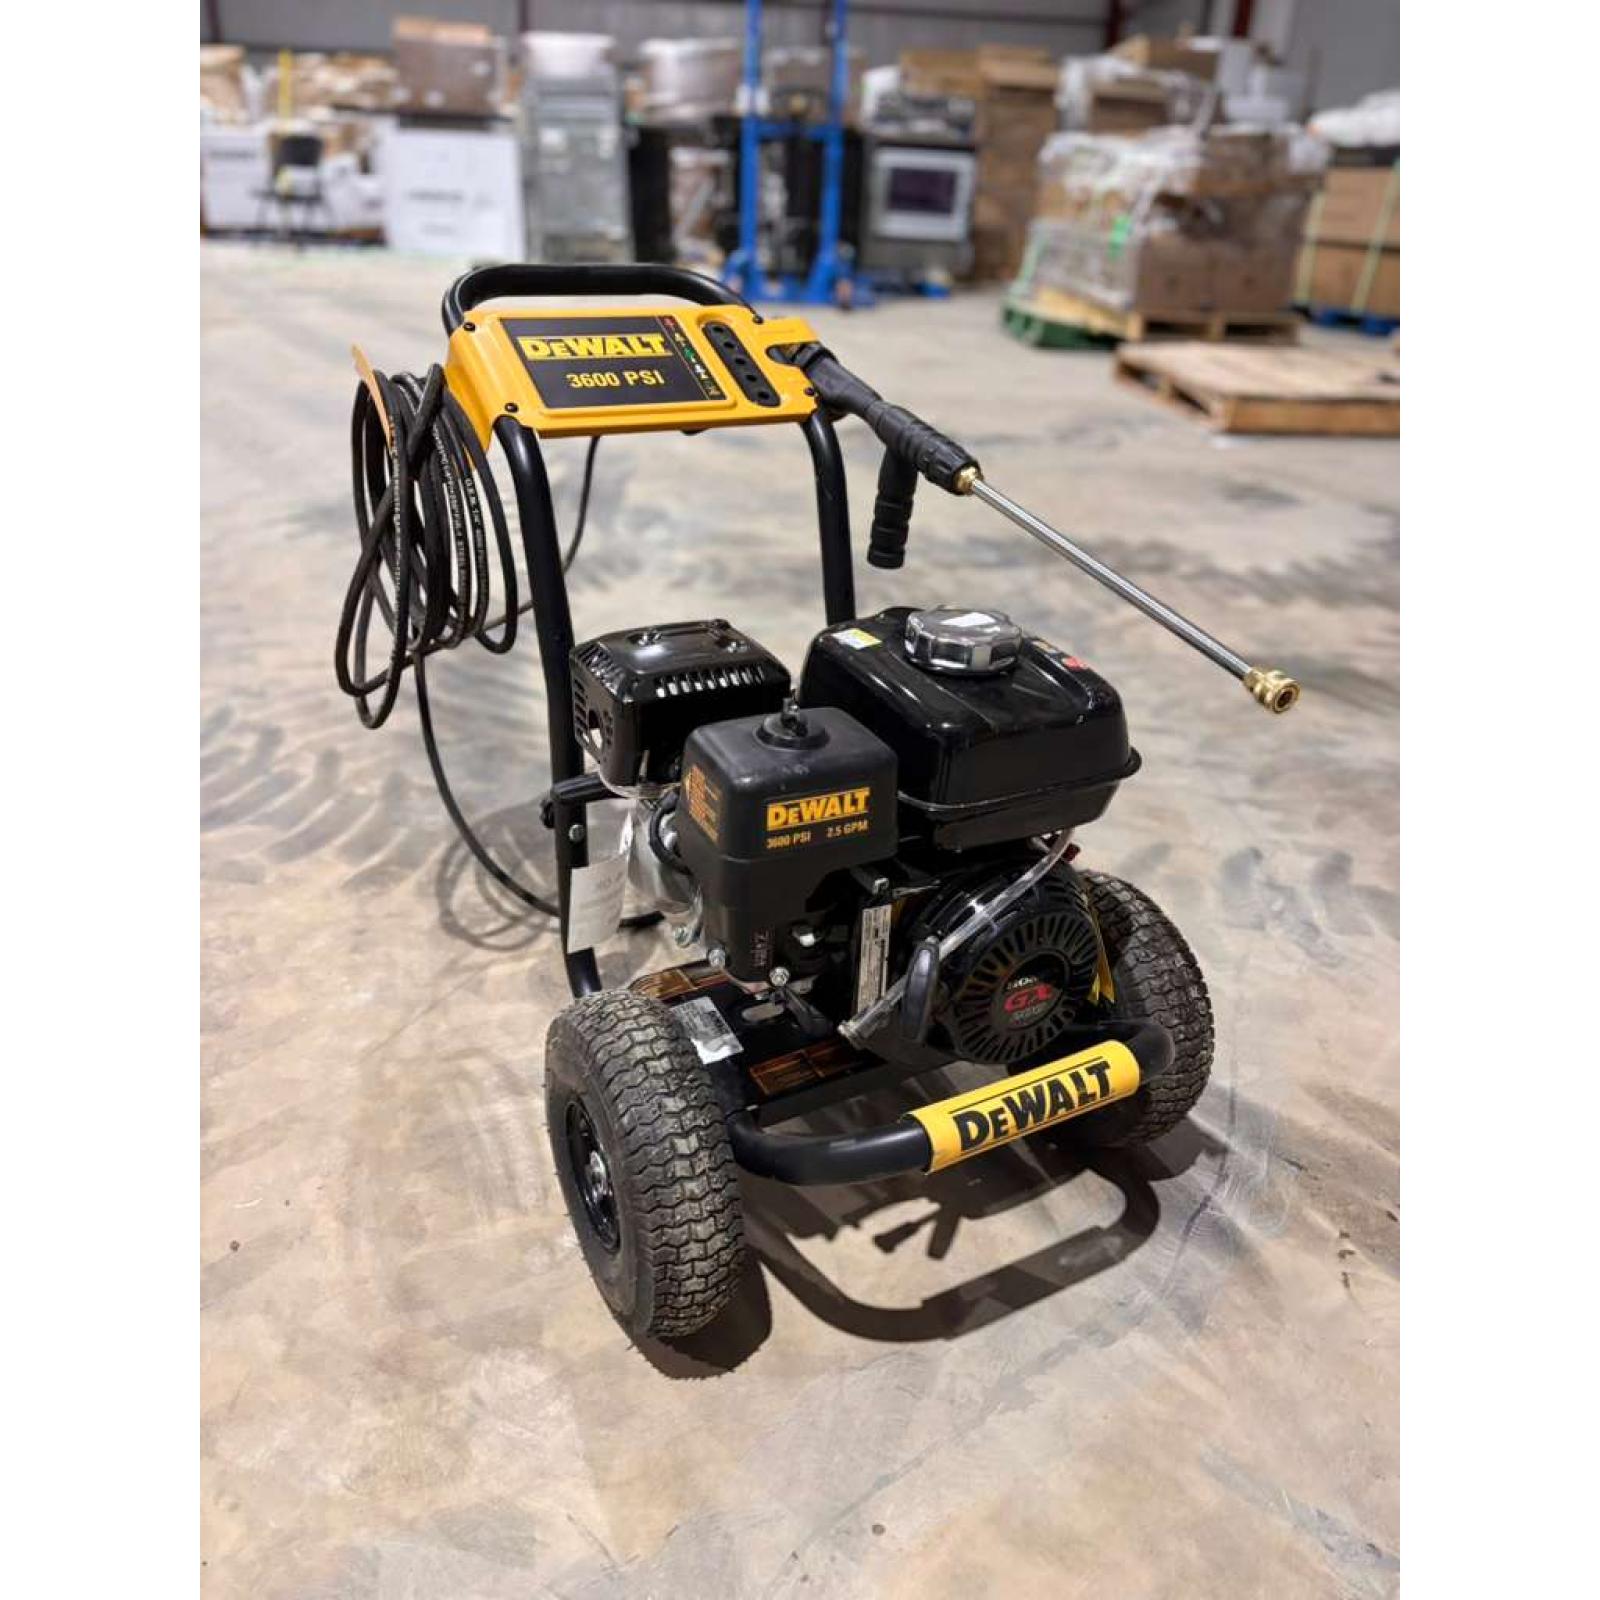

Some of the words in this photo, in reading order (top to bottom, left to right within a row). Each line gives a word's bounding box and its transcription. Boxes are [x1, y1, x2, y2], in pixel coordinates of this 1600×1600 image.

[566, 371, 621, 389] 3600
[623, 368, 666, 387] PSI
[793, 830, 812, 845] PSI
[826, 824, 843, 838] 2.5
[844, 818, 869, 835] GPM
